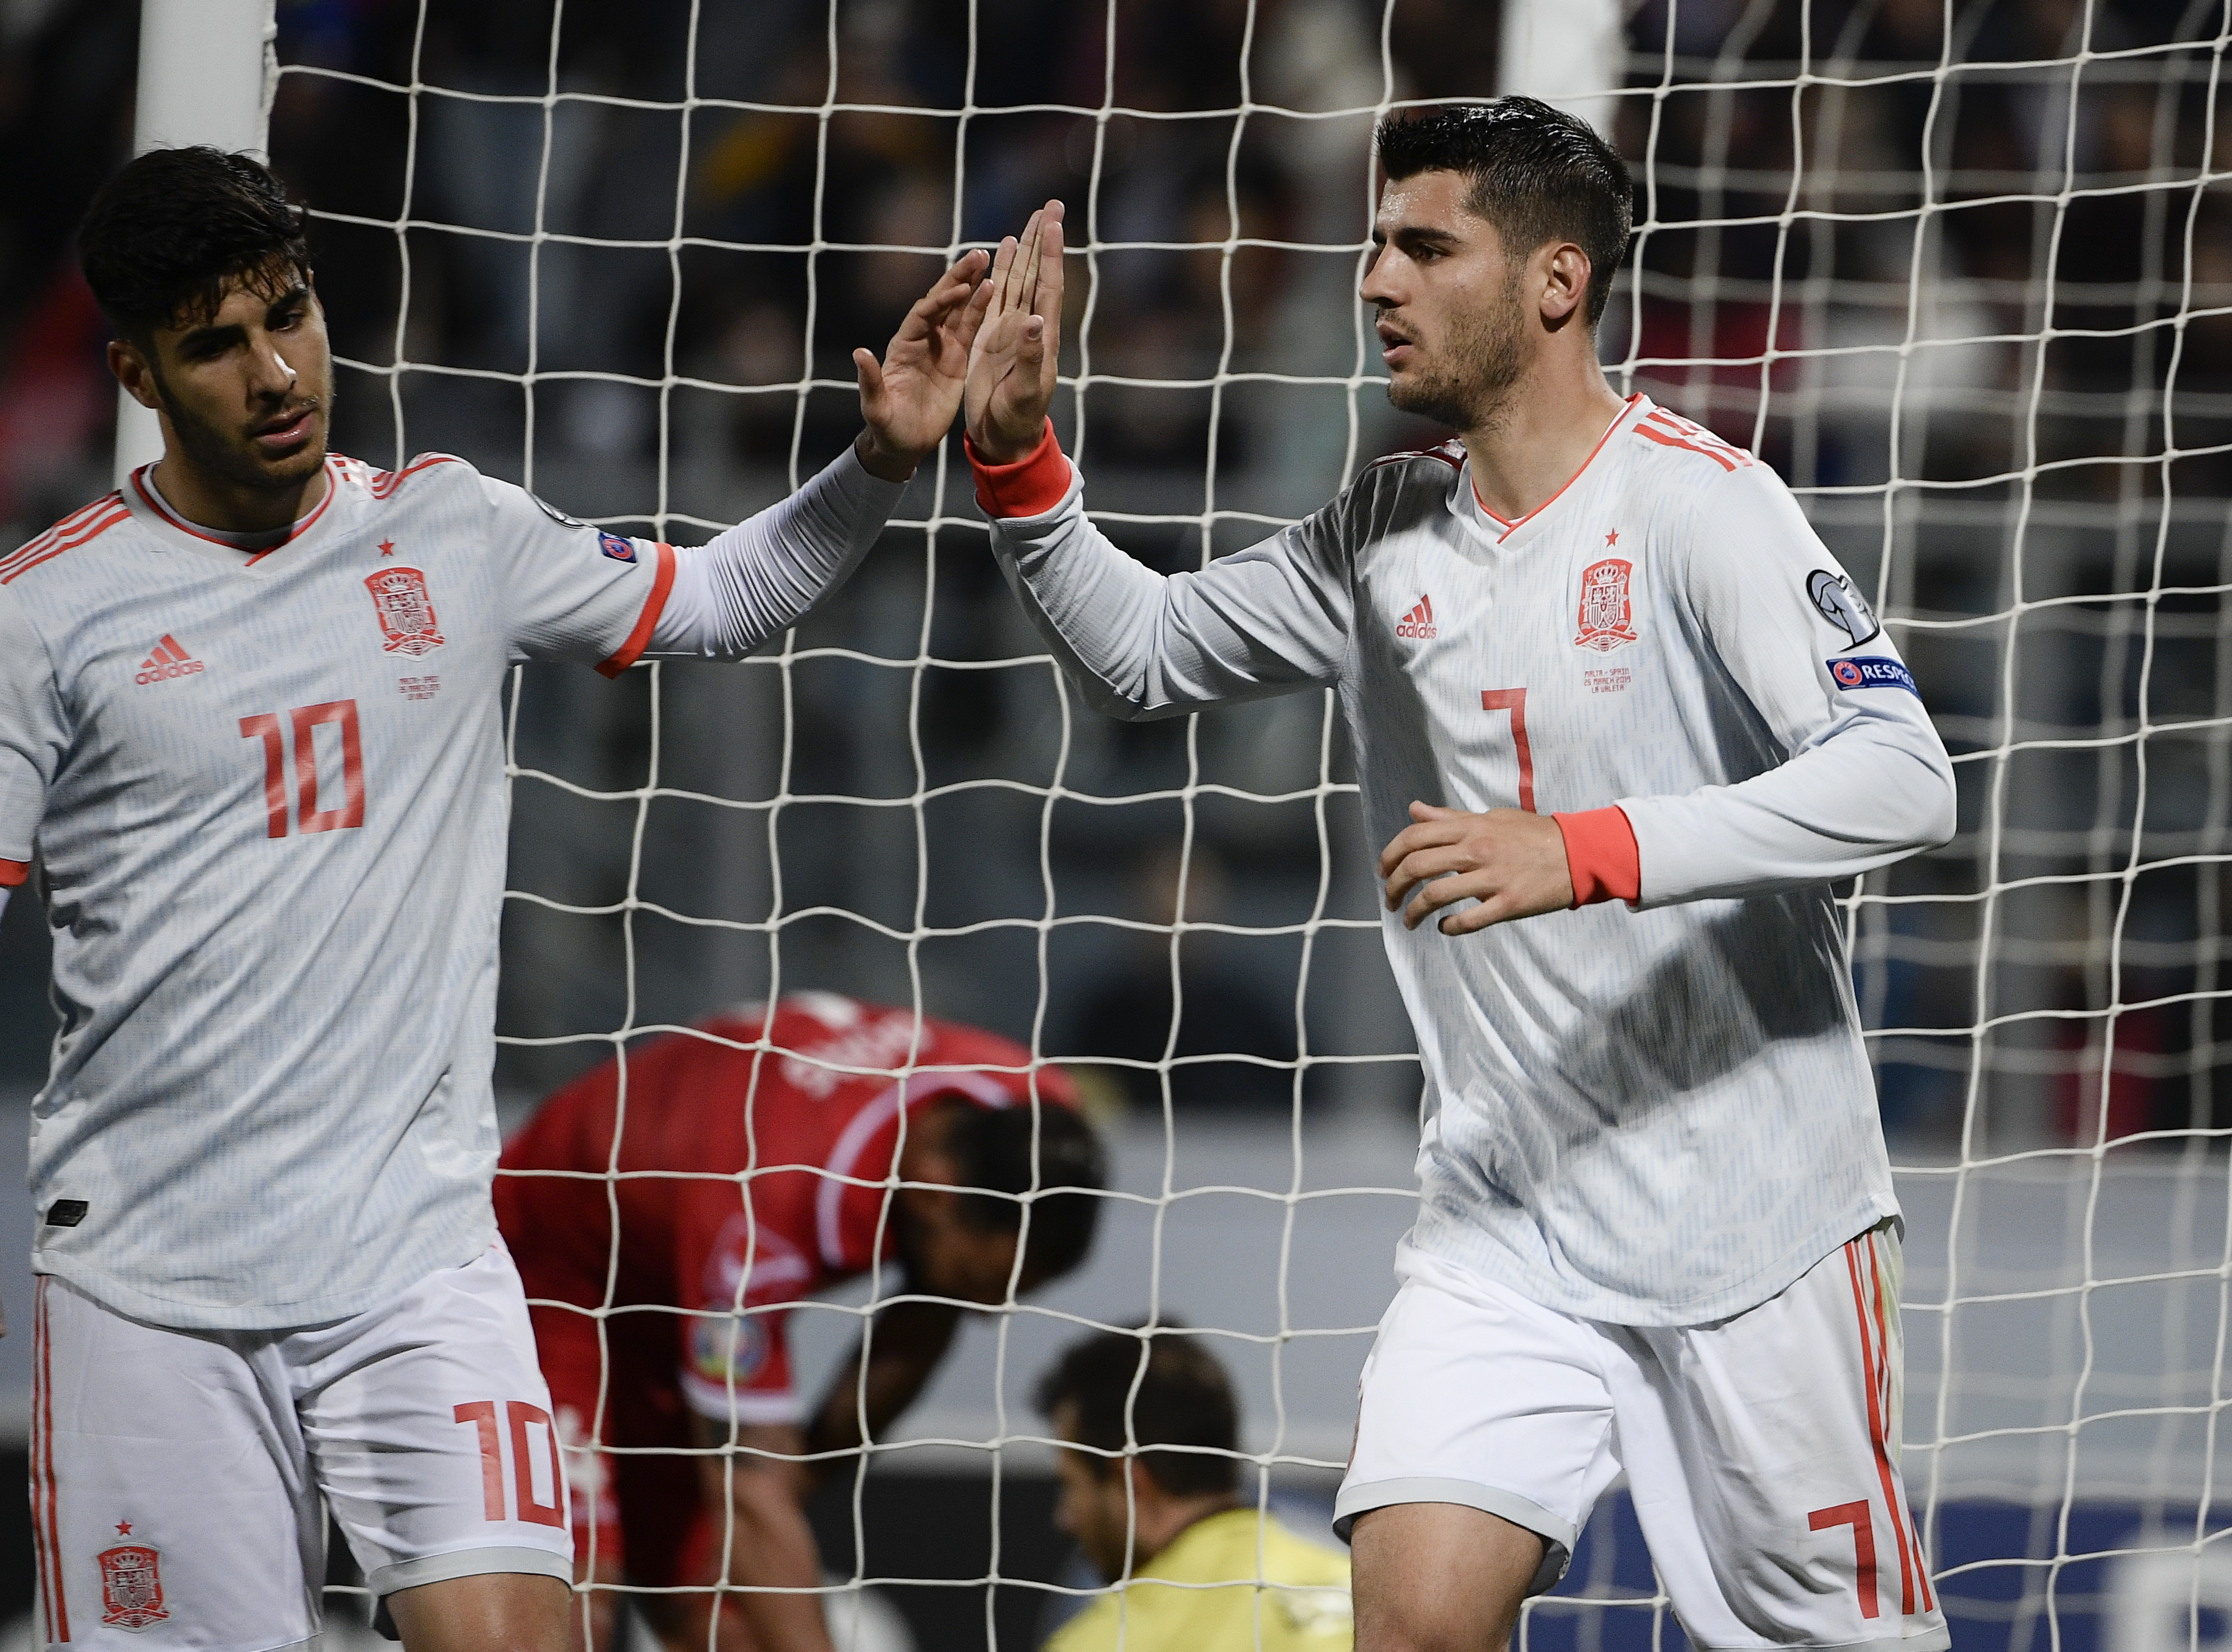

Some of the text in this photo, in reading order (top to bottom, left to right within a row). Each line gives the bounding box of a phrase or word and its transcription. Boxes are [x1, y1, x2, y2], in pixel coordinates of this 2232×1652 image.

[1396, 621, 1437, 639] adidas
[135, 660, 204, 685] adidas
[1584, 670, 1603, 678] MALTA
[1610, 668, 1630, 676] SPAIN
[1593, 677, 1614, 685] MARCH
[1616, 675, 1631, 684] 2019
[1601, 684, 1624, 693] VALETA
[1481, 688, 1536, 814] 7
[239, 699, 365, 838] 10
[454, 1400, 566, 1530] 10
[1807, 1499, 1879, 1619] 7
